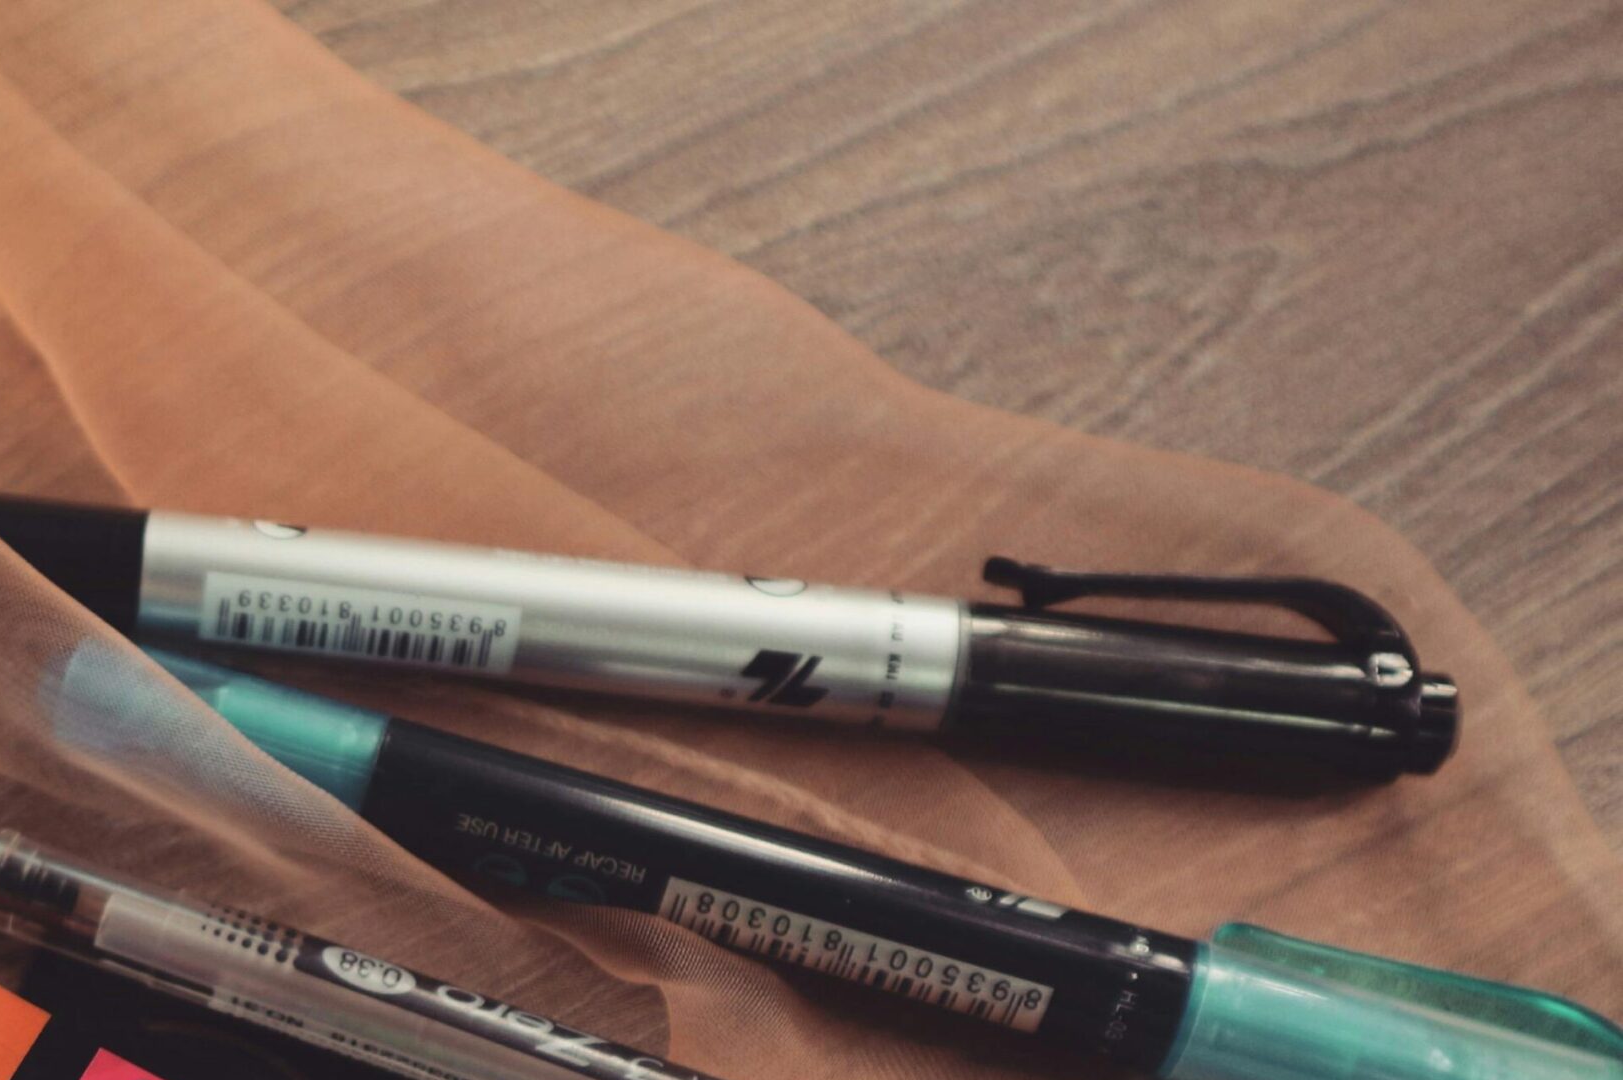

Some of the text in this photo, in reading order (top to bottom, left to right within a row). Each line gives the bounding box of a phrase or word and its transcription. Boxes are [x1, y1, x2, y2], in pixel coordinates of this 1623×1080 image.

[457, 813, 647, 883] RECAP AFTER USE
[340, 950, 403, 989] 0.38
